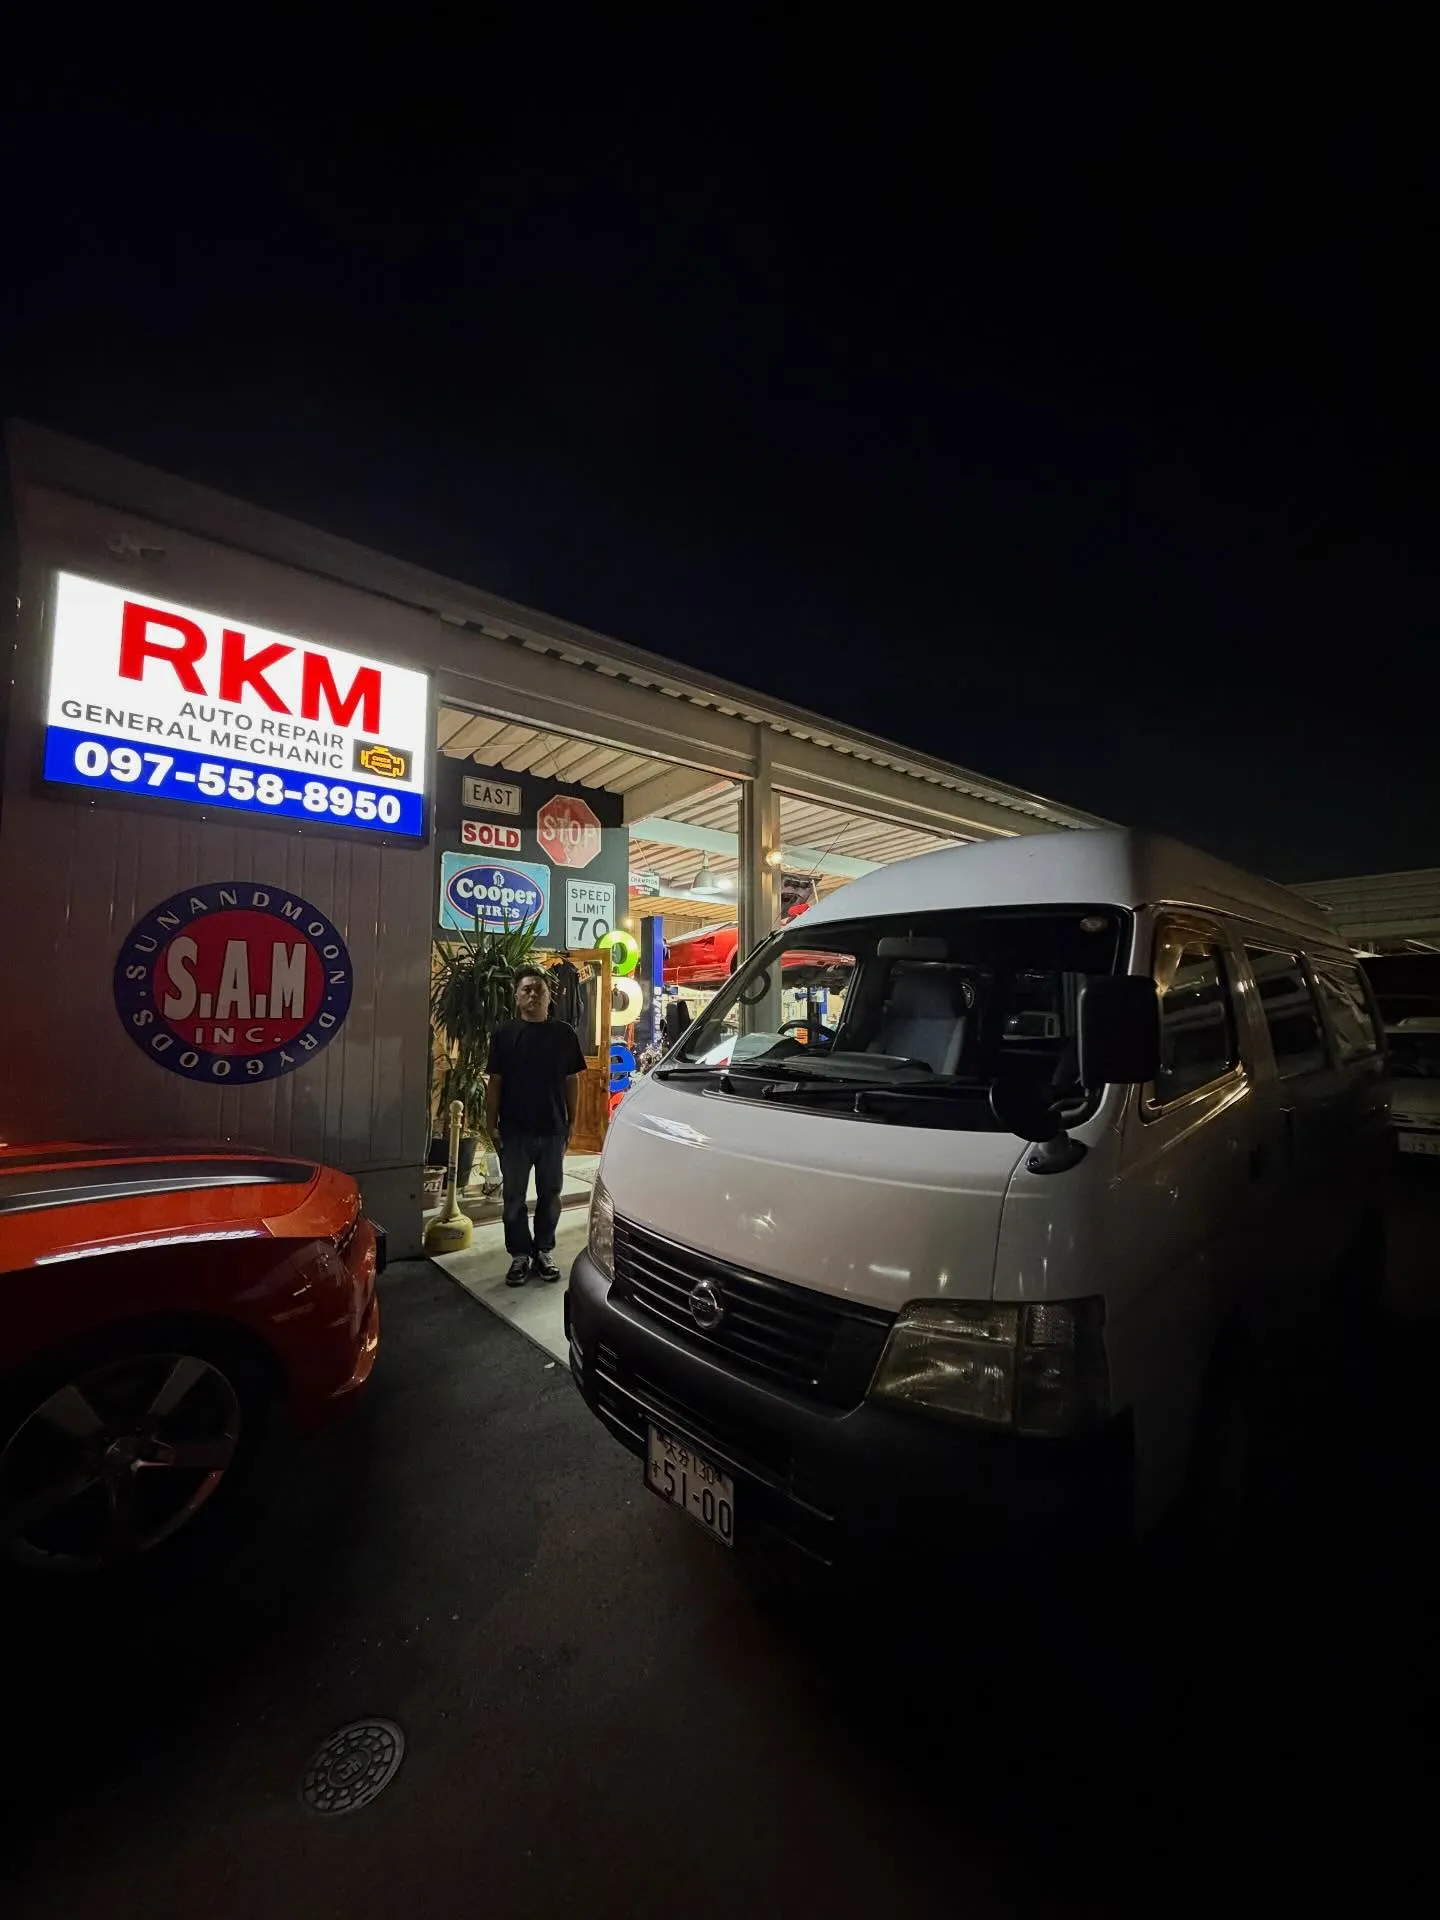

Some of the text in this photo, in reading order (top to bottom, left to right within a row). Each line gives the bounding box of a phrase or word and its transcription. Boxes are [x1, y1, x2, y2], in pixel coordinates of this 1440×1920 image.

[119, 600, 382, 734] RKM
[61, 700, 344, 769] GENERAL MECHANIC
[179, 702, 344, 750] AUTO REPAIR
[74, 742, 401, 824] 097-558-8950
[473, 784, 512, 806] EAST
[464, 823, 519, 848] SOLD
[456, 878, 537, 906] Cooper
[571, 888, 611, 902] SPEED
[476, 904, 520, 919] TIRES
[576, 902, 607, 915] LIMIT
[571, 916, 610, 941] 70
[195, 1027, 282, 1045] INC.
[664, 1457, 731, 1538] 51-00
